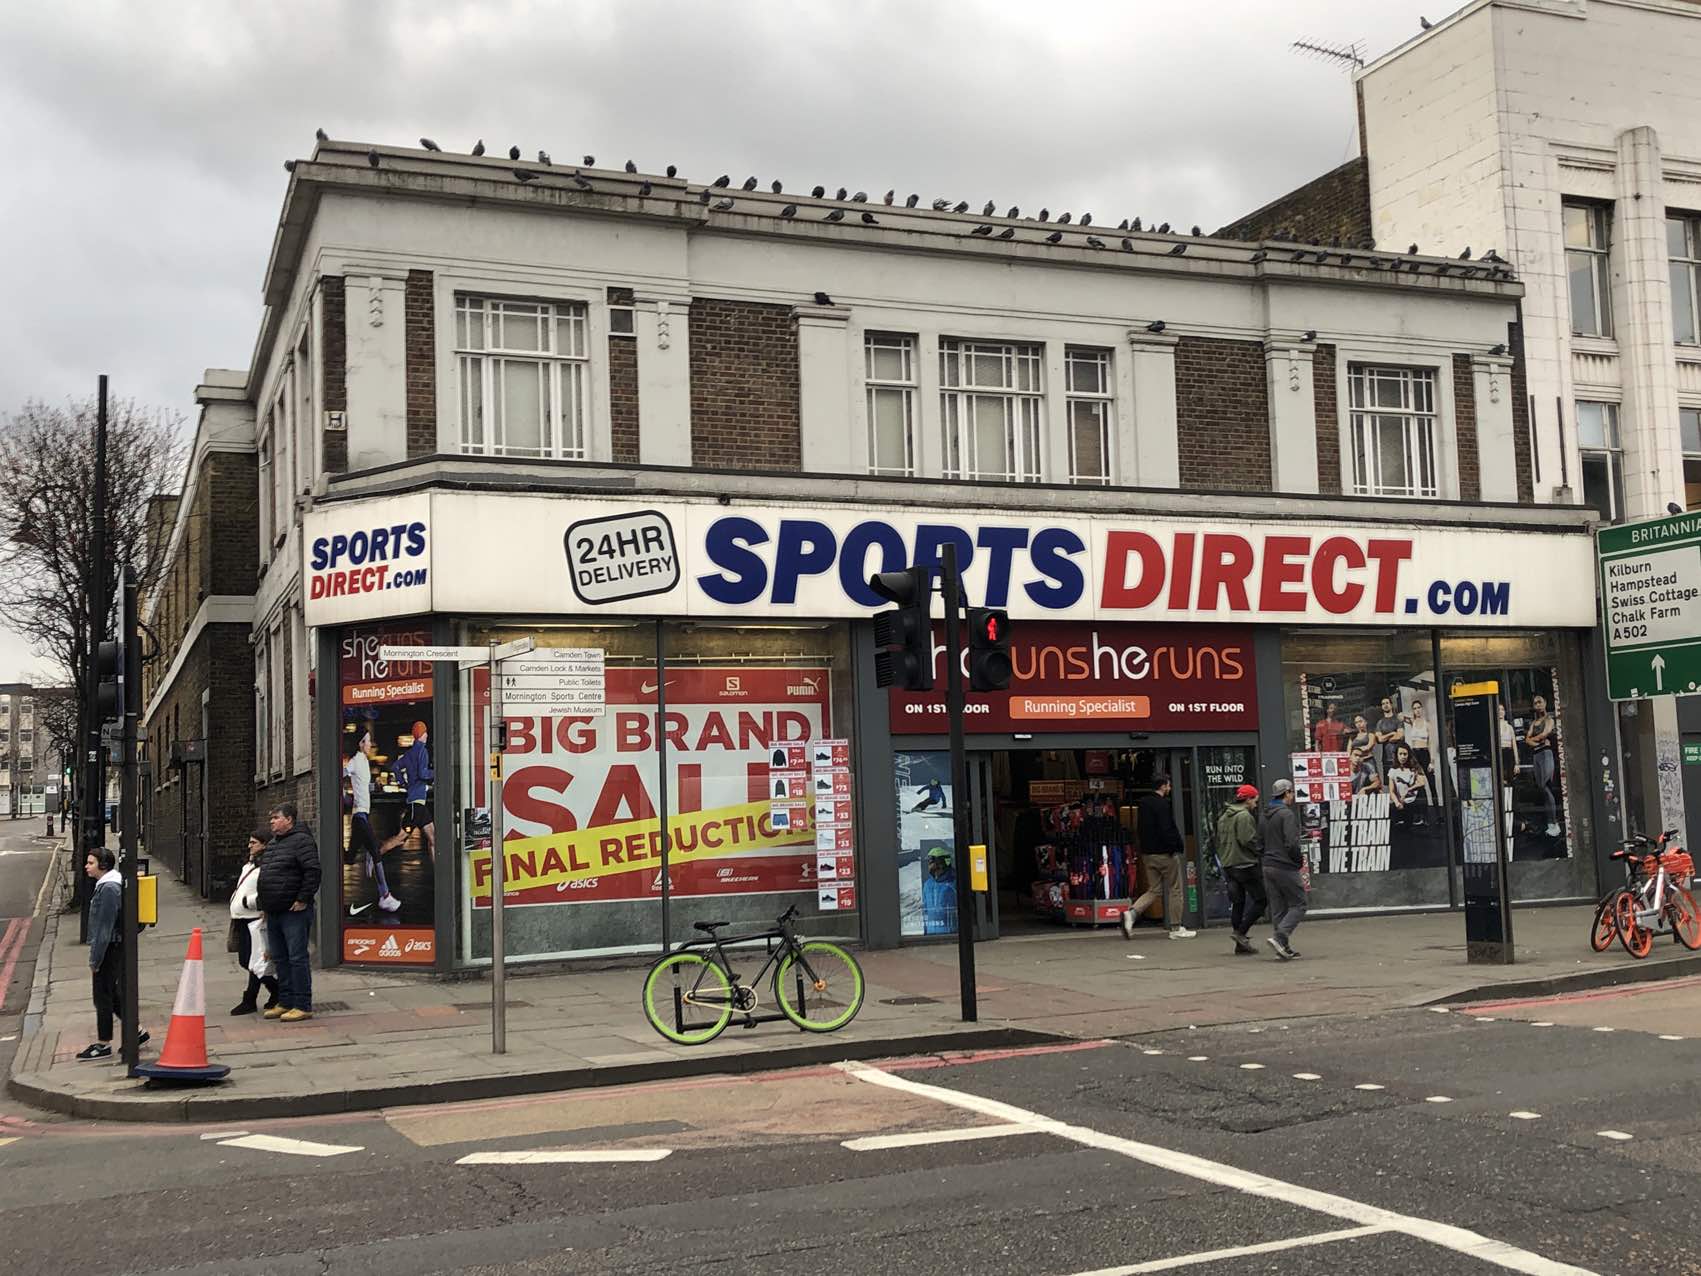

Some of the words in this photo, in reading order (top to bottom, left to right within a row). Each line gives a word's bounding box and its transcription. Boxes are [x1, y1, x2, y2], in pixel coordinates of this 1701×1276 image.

[310, 521, 427, 571] SPORTS
[575, 525, 666, 565] 24HR
[578, 555, 673, 587] DELIVERY
[1609, 562, 1652, 577] Kilburn
[310, 565, 427, 600] DIRECT.COM
[1610, 572, 1678, 593] Hampstead
[1611, 596, 1645, 609] Swiss
[1649, 587, 1698, 604] Cottage
[1612, 610, 1646, 625] Chalk
[1650, 606, 1681, 620] Farm
[383, 649, 425, 659] Mornington
[425, 649, 459, 657] Crescent
[553, 650, 583, 658] Camden
[519, 664, 549, 672] Camden
[550, 664, 567, 672] Lock
[575, 664, 601, 672] Markets
[352, 687, 386, 699] Running
[386, 682, 425, 698] Specialist
[559, 678, 579, 686] Public
[580, 678, 601, 686] Toilets
[505, 692, 547, 702] Mornington
[550, 692, 575, 702] Sports
[578, 692, 602, 701] Centre
[548, 706, 573, 714] Jewish
[573, 706, 603, 714] Museum
[905, 703, 923, 714] ON
[962, 703, 990, 714] OOR
[1024, 699, 1076, 715] Running
[1078, 699, 1136, 714] Specialist
[1168, 703, 1185, 712] ON
[1187, 703, 1208, 712] 1ST
[1209, 703, 1245, 712] FLOOR
[503, 715, 598, 755] BIG
[616, 711, 811, 752] BRAND
[1205, 765, 1223, 774] RUN
[1224, 764, 1245, 774] INTO
[1207, 774, 1222, 783] THE
[1223, 774, 1244, 783] WILD
[1329, 800, 1348, 820] WE
[1350, 792, 1391, 819] TRAIN
[1329, 820, 1349, 847] WE
[1350, 819, 1391, 846] TRAIN
[473, 844, 590, 887] FINAL
[1329, 847, 1349, 873] WE
[1350, 845, 1391, 872] TRAIN
